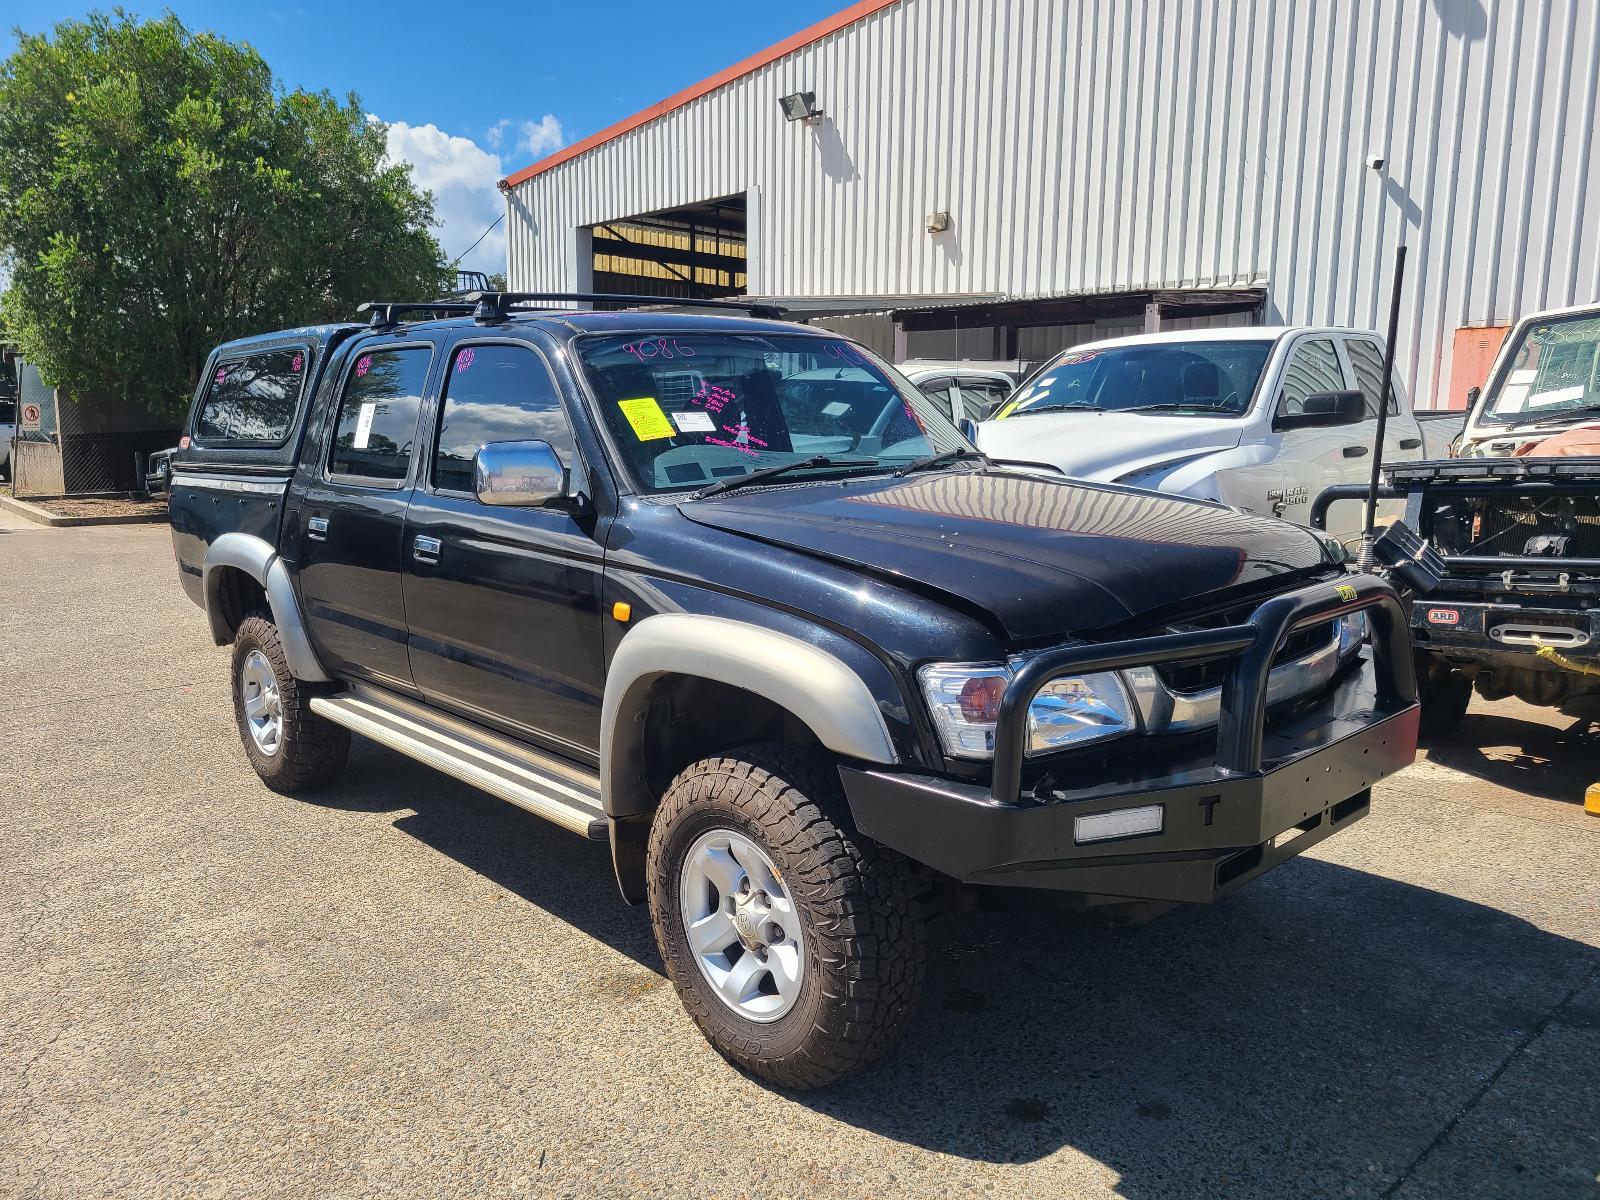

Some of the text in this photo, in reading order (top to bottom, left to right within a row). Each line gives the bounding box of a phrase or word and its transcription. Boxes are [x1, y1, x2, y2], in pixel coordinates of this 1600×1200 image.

[622, 338, 696, 362] 9086
[1432, 612, 1455, 621] ARB
[711, 1017, 762, 1057] OPEN
